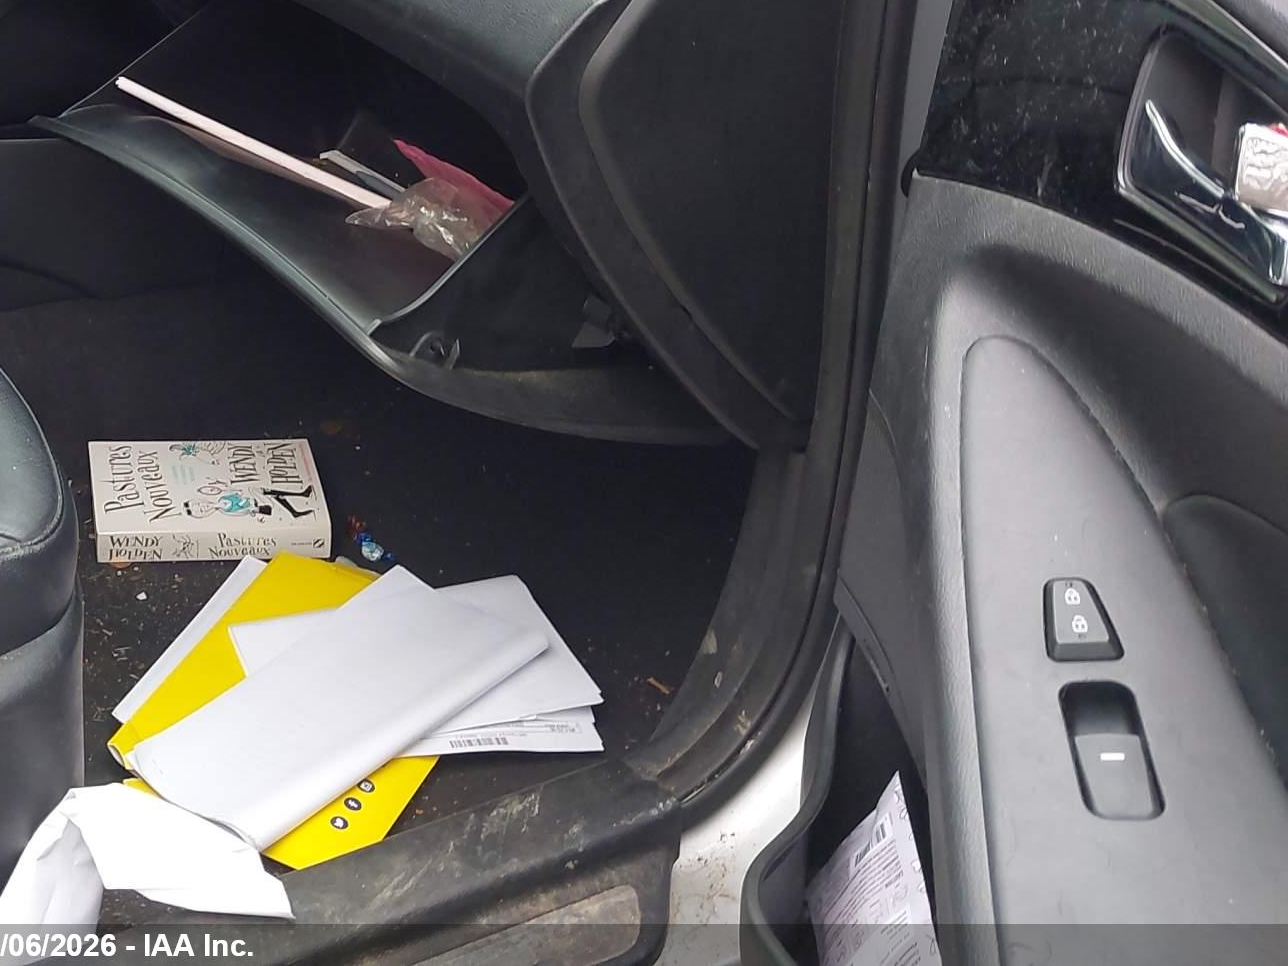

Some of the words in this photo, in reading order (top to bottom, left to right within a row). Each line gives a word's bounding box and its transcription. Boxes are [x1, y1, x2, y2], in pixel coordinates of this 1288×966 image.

[227, 442, 260, 484] WENDY
[264, 442, 303, 484] HOLDEN
[100, 445, 145, 514] Pastures
[137, 450, 182, 522] Nouveaux
[109, 535, 163, 548] WENDY
[109, 548, 163, 560] HOLDEN
[208, 545, 270, 559] Nouveaux
[217, 532, 277, 548] Pastures
